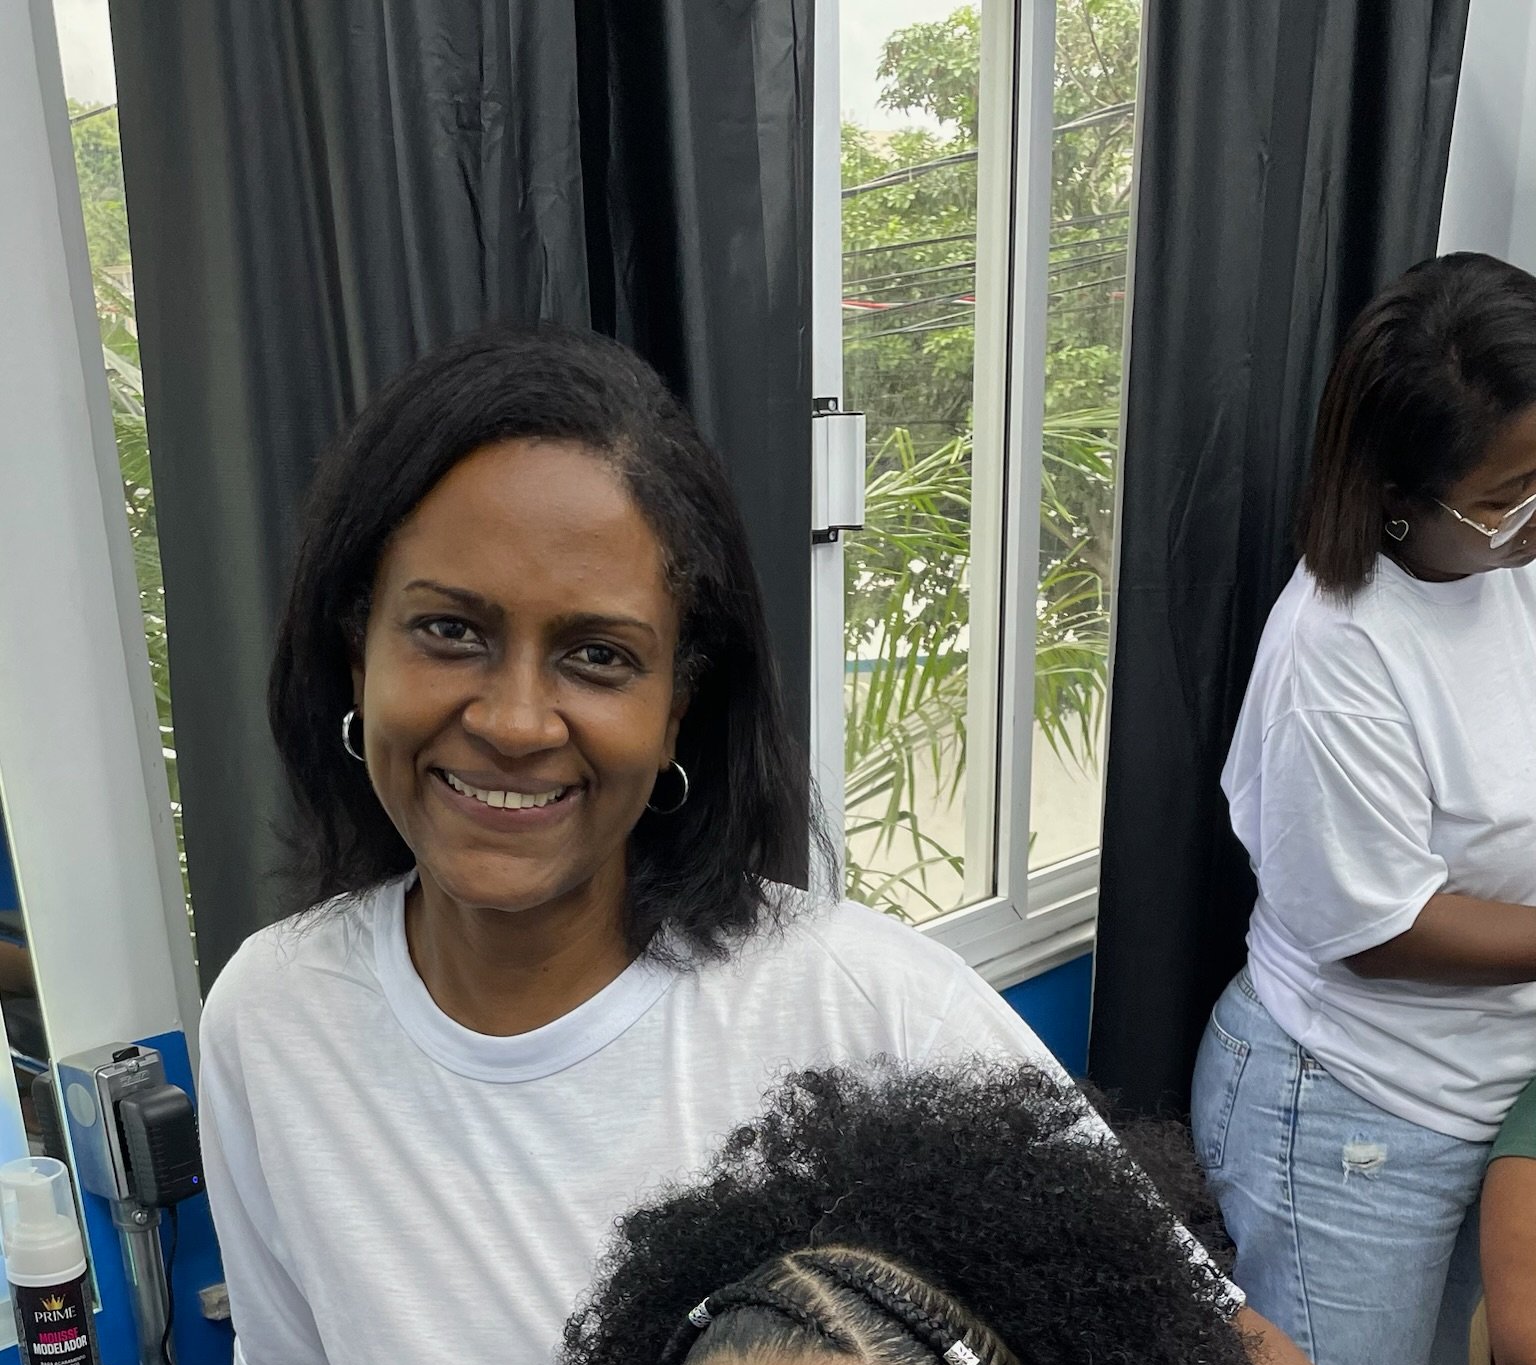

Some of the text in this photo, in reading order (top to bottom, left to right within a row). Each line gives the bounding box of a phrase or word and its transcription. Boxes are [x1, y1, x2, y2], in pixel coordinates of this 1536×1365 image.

[34, 1305, 77, 1323] PRIME
[39, 1327, 78, 1344] MOUSSE
[33, 1335, 88, 1355] MODELADOR
